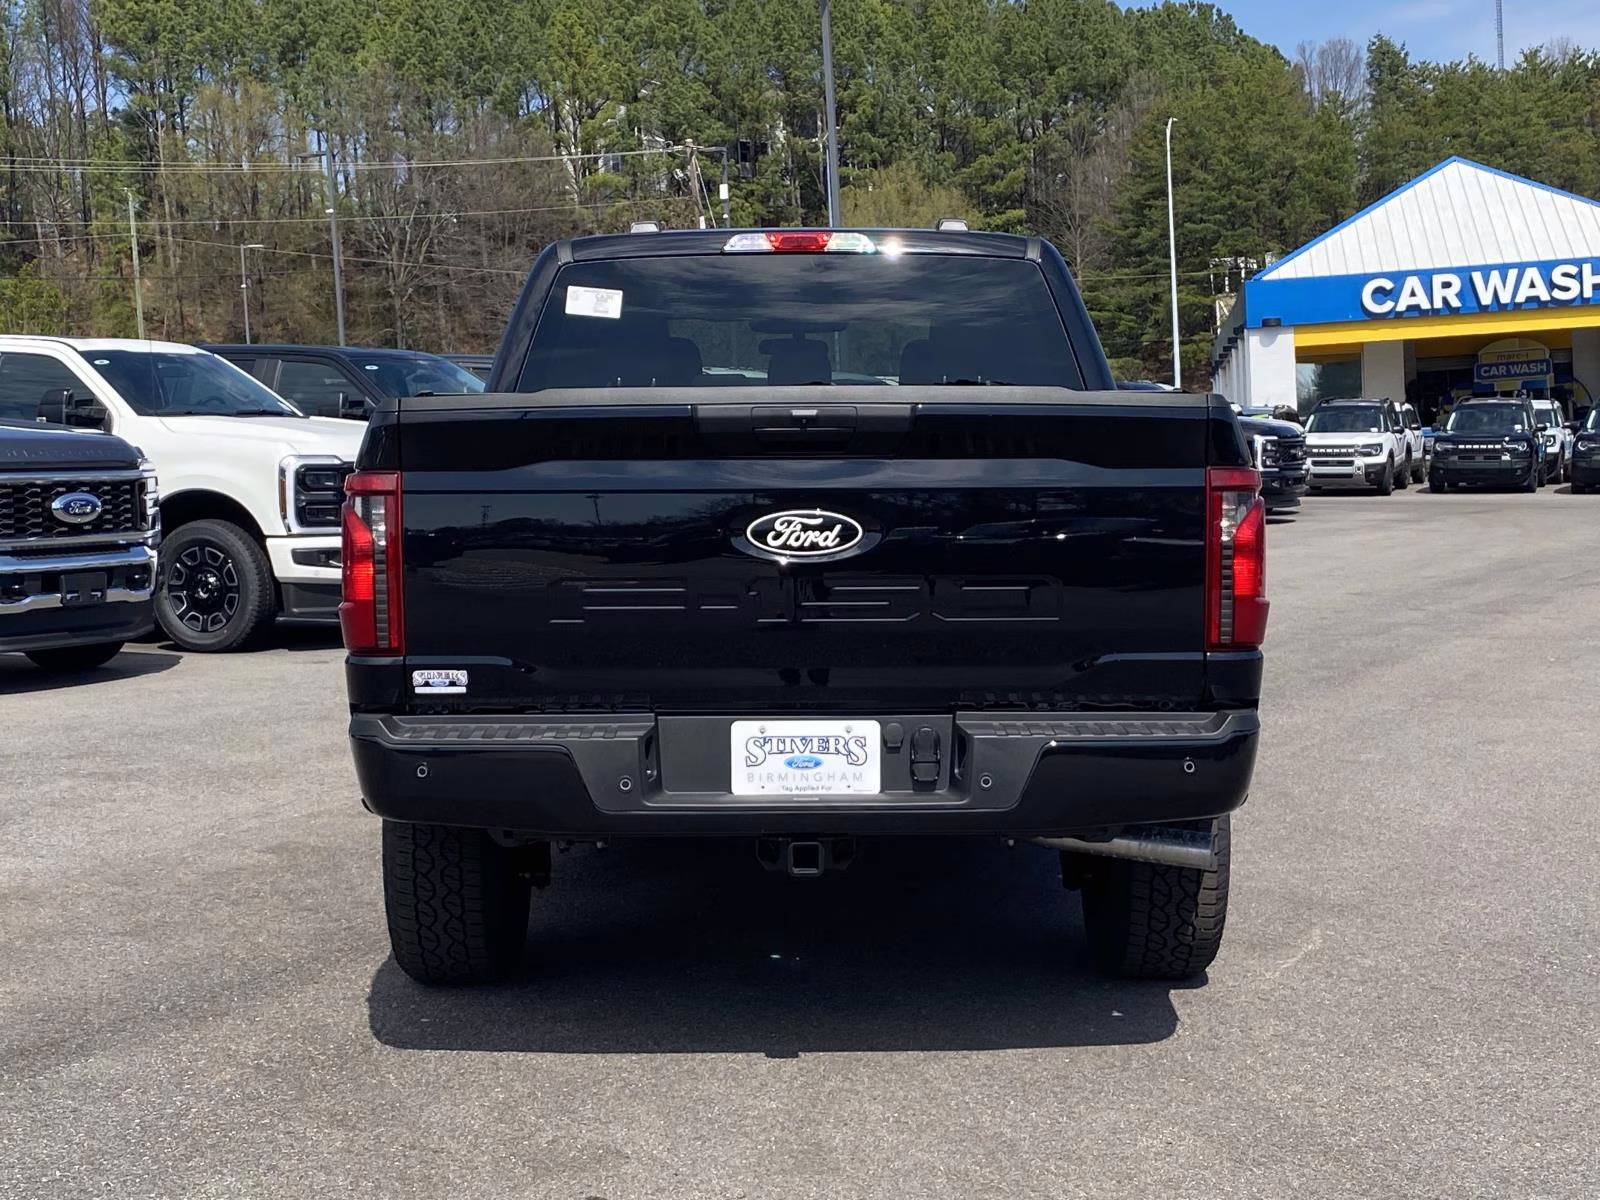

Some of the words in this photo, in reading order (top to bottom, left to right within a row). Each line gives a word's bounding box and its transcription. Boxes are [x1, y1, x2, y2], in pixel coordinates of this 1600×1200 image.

[1361, 273, 1462, 314] CAR
[1480, 366, 1507, 377] CAR
[1508, 362, 1547, 375] WASH
[68, 500, 92, 514] Ford
[766, 516, 842, 547] Ford
[745, 735, 868, 767] STIVERS
[746, 772, 864, 783] BIRMINGHAM
